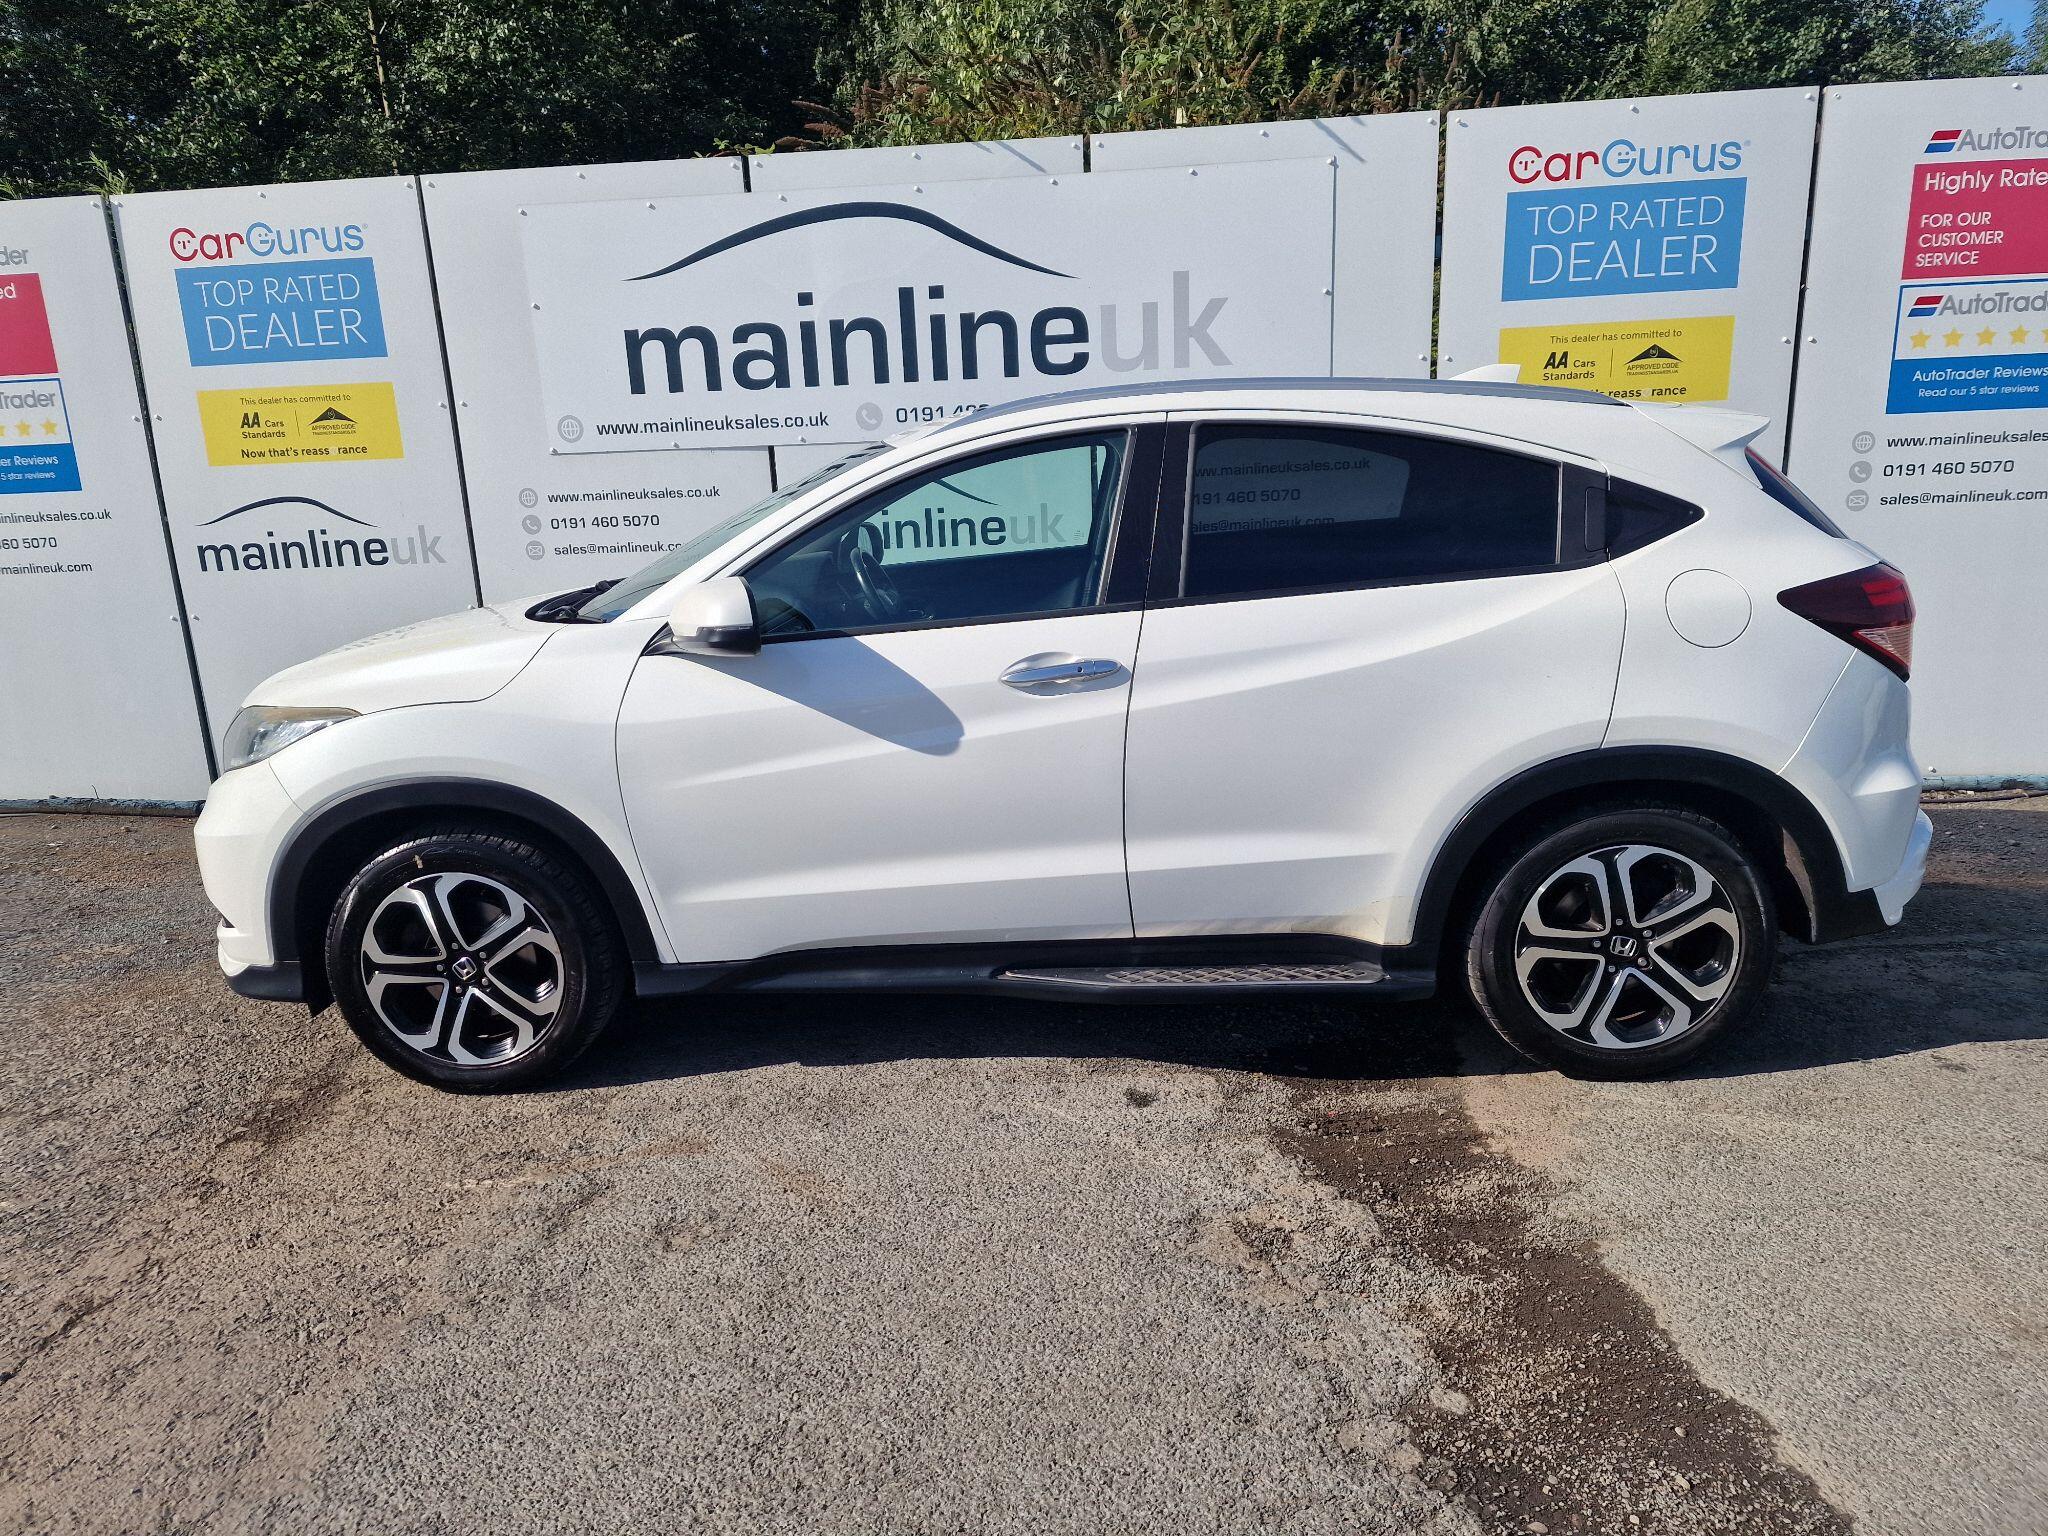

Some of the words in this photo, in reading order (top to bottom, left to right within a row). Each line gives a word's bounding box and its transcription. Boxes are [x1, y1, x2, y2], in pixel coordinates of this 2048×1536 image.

[1508, 138, 1742, 184] CarGurus
[1924, 170, 1993, 194] Highly
[1527, 203, 1598, 236] TOP
[1609, 195, 1724, 231] RATED
[1920, 213, 1952, 228] FOR
[1957, 212, 1991, 226] OUR
[169, 222, 364, 261] CarGurus
[1918, 231, 2004, 247] CUSTOMER
[1529, 234, 1718, 285] DEALER
[1915, 251, 1980, 267] SERVICE
[193, 279, 254, 308] TOP
[263, 273, 361, 304] RATED
[1938, 291, 2048, 316] AutoTrad
[205, 308, 368, 351] DEALER
[623, 271, 1233, 395] mainlineuk
[1550, 336, 1569, 344] This
[1572, 335, 1600, 343] dealer
[1602, 333, 1618, 341] has
[1620, 329, 1670, 340] committed
[1673, 329, 1682, 337] to
[1543, 351, 1569, 369] AA
[1573, 359, 1596, 368] Cars
[1627, 363, 1660, 371] APPROVED
[1542, 370, 1595, 380] Standards
[1912, 367, 1990, 382] AutoTrader
[1994, 366, 2048, 379] Reviews
[1918, 387, 1947, 398] Read
[1950, 387, 1968, 396] our
[1970, 386, 1977, 395] 5
[1979, 385, 1998, 394] star
[2001, 384, 2040, 393] reviews
[240, 397, 257, 406] This
[258, 396, 282, 405] dealer
[283, 396, 297, 404] has
[299, 394, 339, 403] committed
[240, 412, 261, 428] AA
[265, 420, 284, 428] Cars
[896, 406, 944, 423] 0191
[596, 411, 829, 436] www.mainlineuksales.co.uk
[242, 430, 286, 439] Standards
[241, 449, 266, 458] Now
[268, 446, 299, 457] that's
[14, 455, 58, 466] Reviews
[1194, 457, 1370, 477] ww.mainlineuksales.co.uk
[1883, 463, 1926, 477] 0191
[1932, 462, 1965, 475] 460
[1970, 460, 2014, 473] 5070
[548, 486, 720, 502] www.mainlineuksales.co.uk
[1226, 490, 1256, 504] 460
[1261, 488, 1300, 502] 5070
[1880, 489, 2047, 505] sales@mainlineuk.com
[0, 509, 112, 524] inlineuksales.co.uk
[551, 518, 586, 529] 0191
[591, 516, 619, 527] 460
[623, 515, 660, 527] 5070
[881, 503, 1066, 549] inlineuk
[22, 537, 57, 549] 5070
[197, 525, 447, 572] mainlineuk
[554, 541, 682, 555] sales@mainlineuk.c
[0, 561, 92, 575] mainlineuk.com
